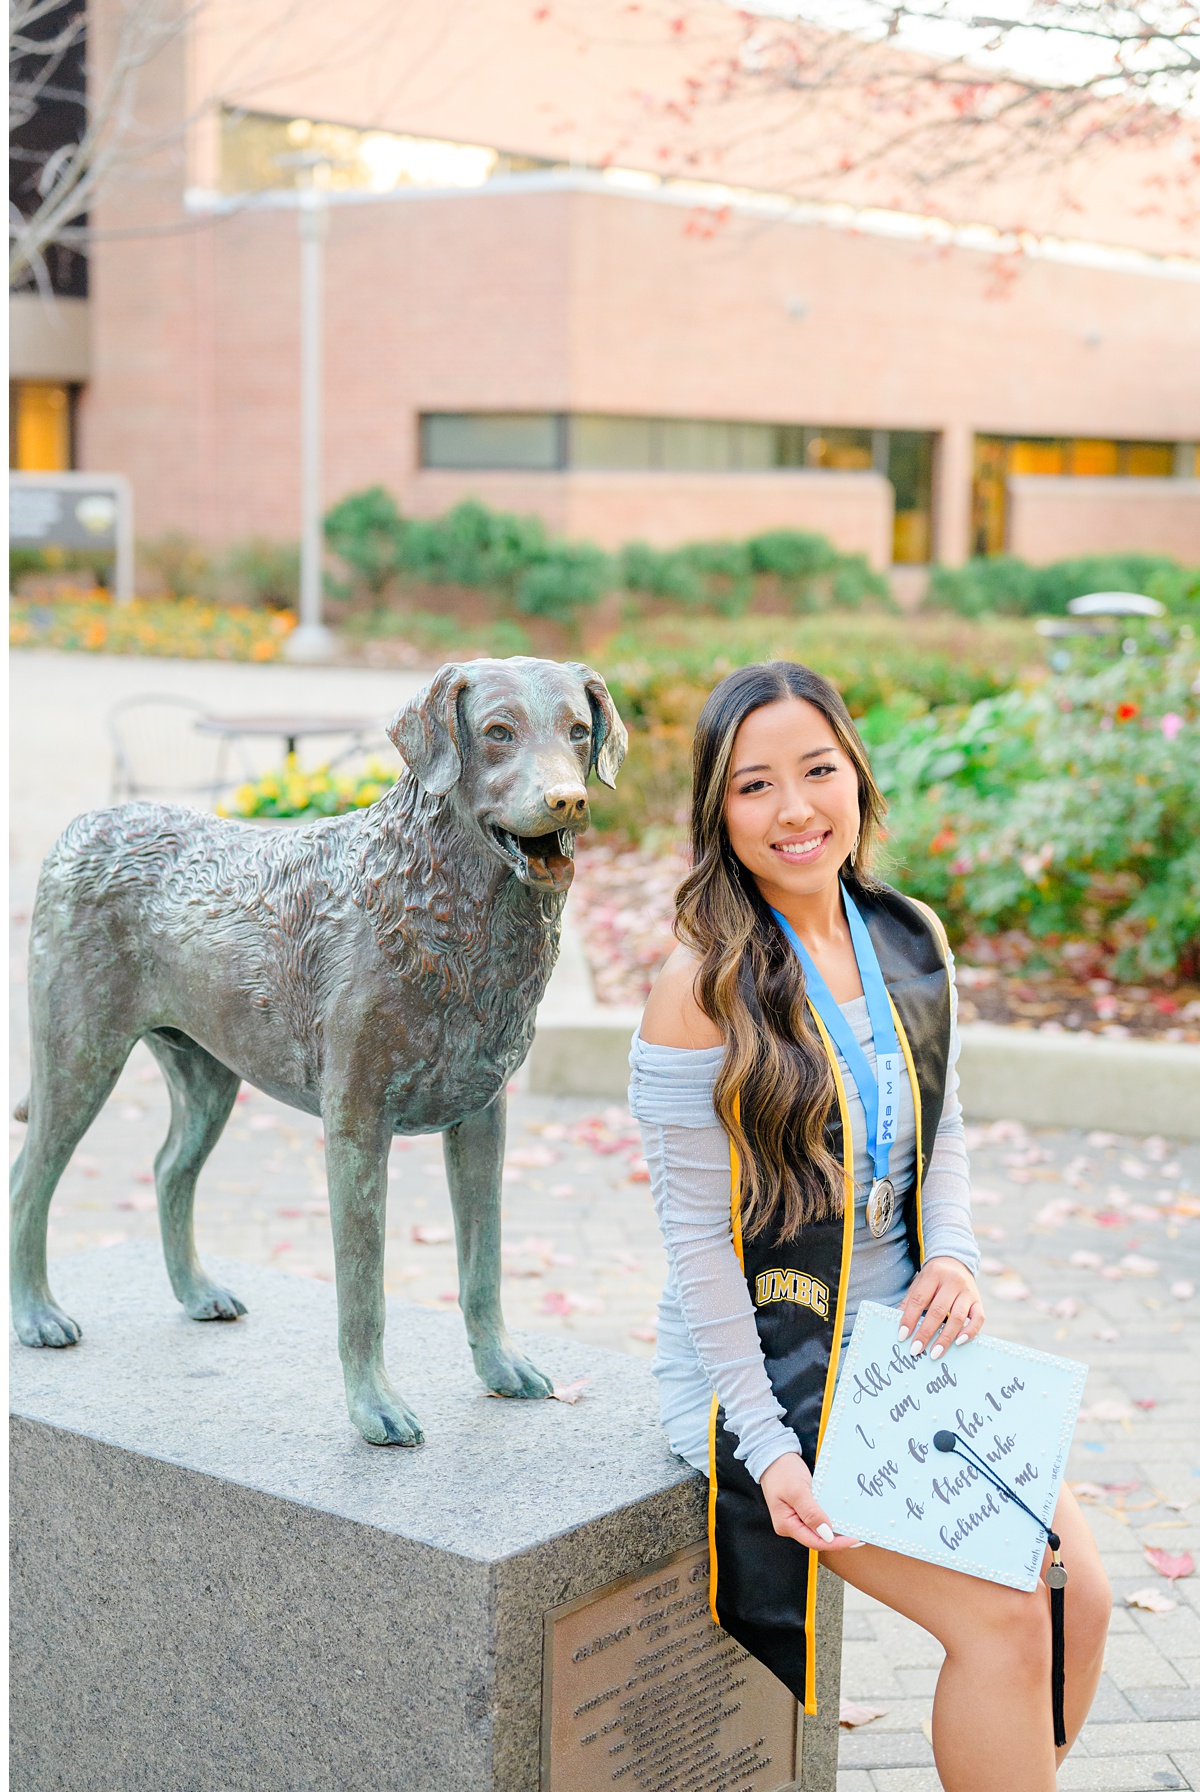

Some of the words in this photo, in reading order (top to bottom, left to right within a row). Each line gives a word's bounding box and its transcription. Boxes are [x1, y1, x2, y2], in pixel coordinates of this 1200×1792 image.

[756, 1268, 829, 1317] UMBC
[853, 1363, 891, 1404] All
[890, 1394, 920, 1422] am
[926, 1363, 957, 1394] and
[857, 1458, 900, 1497] hope
[908, 1438, 928, 1463] to
[955, 1409, 993, 1438] be,
[907, 1498, 925, 1520] to
[932, 1465, 979, 1505] those
[986, 1433, 1017, 1462] who
[939, 1493, 1000, 1551] believed
[1015, 1462, 1039, 1486] me
[634, 1576, 679, 1606] "TRUE
[572, 1624, 631, 1663] CHAMPION
[636, 1590, 703, 1630] CHESAPEAKE
[646, 1624, 670, 1643] AND
[674, 1602, 710, 1629] MASCO
[635, 1636, 688, 1670] PRESENTED
